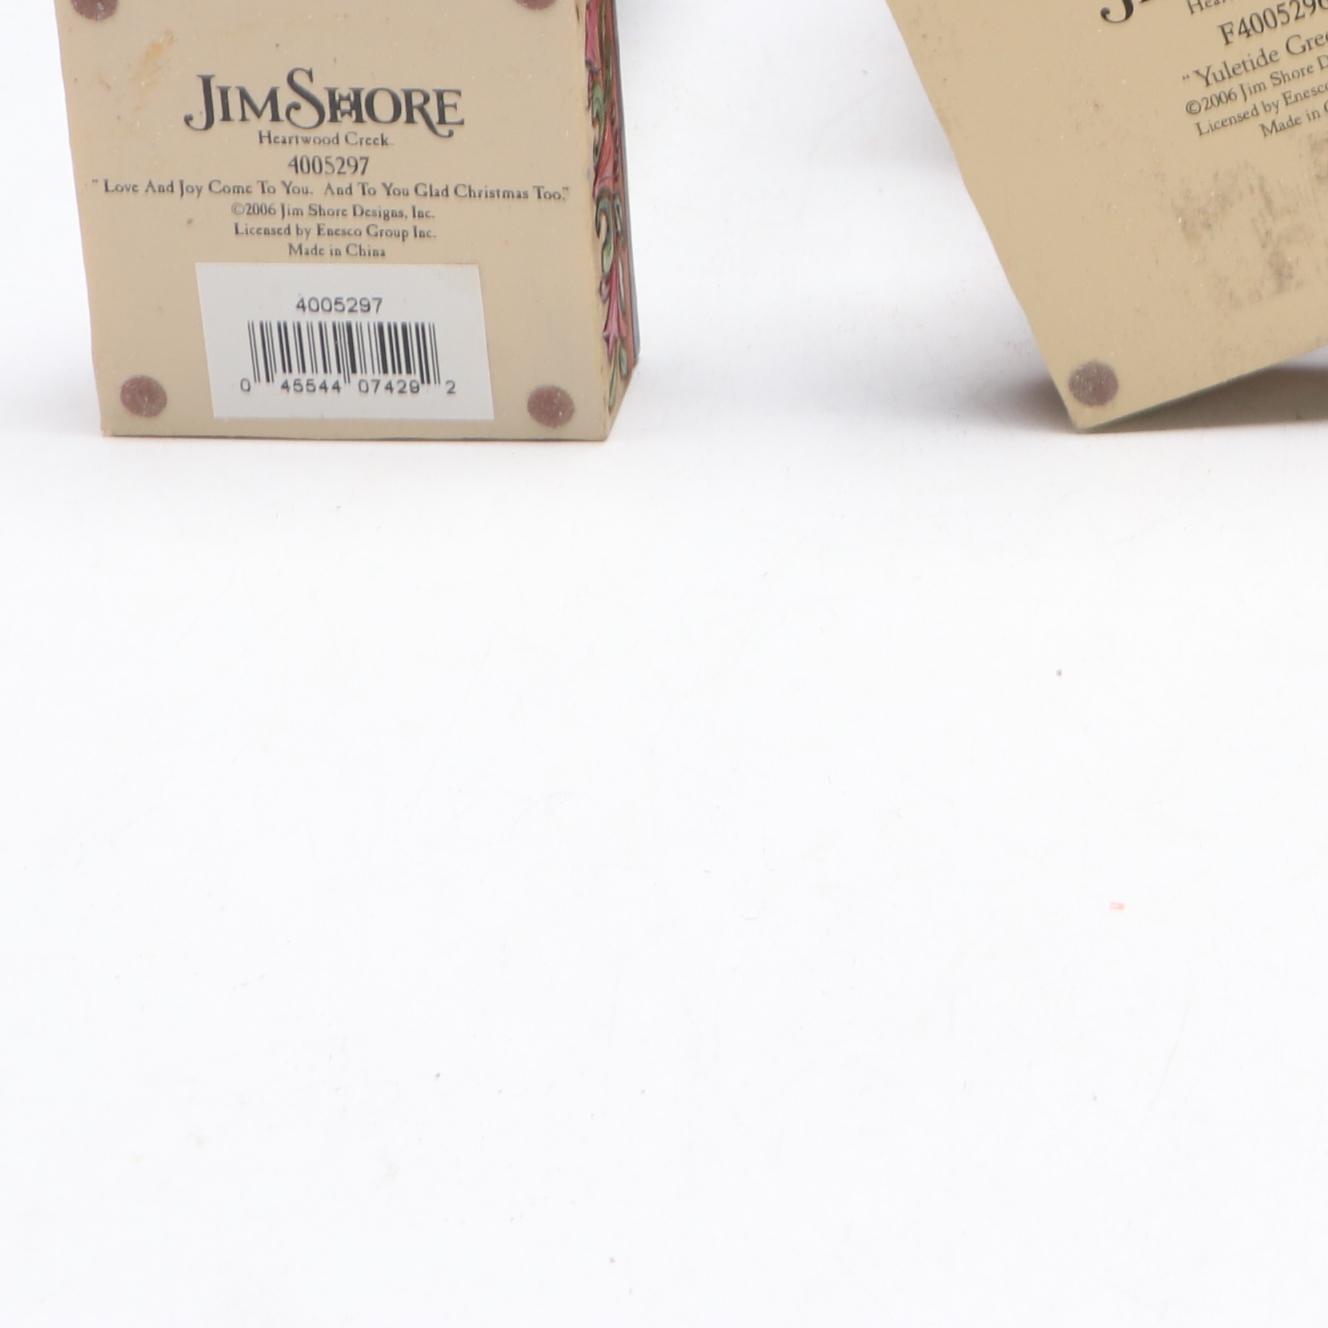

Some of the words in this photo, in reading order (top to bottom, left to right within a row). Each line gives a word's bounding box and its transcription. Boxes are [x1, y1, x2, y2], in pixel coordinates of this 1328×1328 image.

[1185, 88, 1238, 115] ©2006
[1239, 81, 1267, 103] Jim
[1269, 63, 1314, 87] Shore
[1195, 102, 1260, 137] Licensed
[1261, 99, 1280, 114] by
[1259, 116, 1302, 138] Made
[1306, 109, 1321, 122] in
[258, 129, 341, 146] Heartwood
[288, 155, 370, 176] 4005297
[144, 179, 175, 194] And
[179, 179, 204, 199] Joy
[208, 179, 253, 195] Come
[257, 180, 276, 195] To
[324, 181, 353, 196] And
[356, 181, 377, 197] To
[381, 182, 410, 197] You
[414, 182, 449, 198] Glad
[454, 183, 529, 200] Christmas
[231, 202, 277, 216] ©2006
[280, 203, 304, 220] Jim
[308, 203, 348, 218] Shore
[352, 204, 408, 221] Designs,
[412, 205, 436, 219] Inc.
[234, 222, 291, 236] Licensed
[295, 222, 312, 240] by
[316, 223, 362, 238] Enesco
[366, 224, 409, 242] Group
[413, 225, 437, 239] Inc.
[289, 242, 325, 257] Made
[329, 244, 342, 257] in
[346, 243, 386, 258] China
[295, 297, 384, 314] 4005297
[240, 378, 251, 394] 0
[280, 378, 342, 395] 45544
[358, 378, 421, 395] 07429
[446, 379, 457, 395] 2
